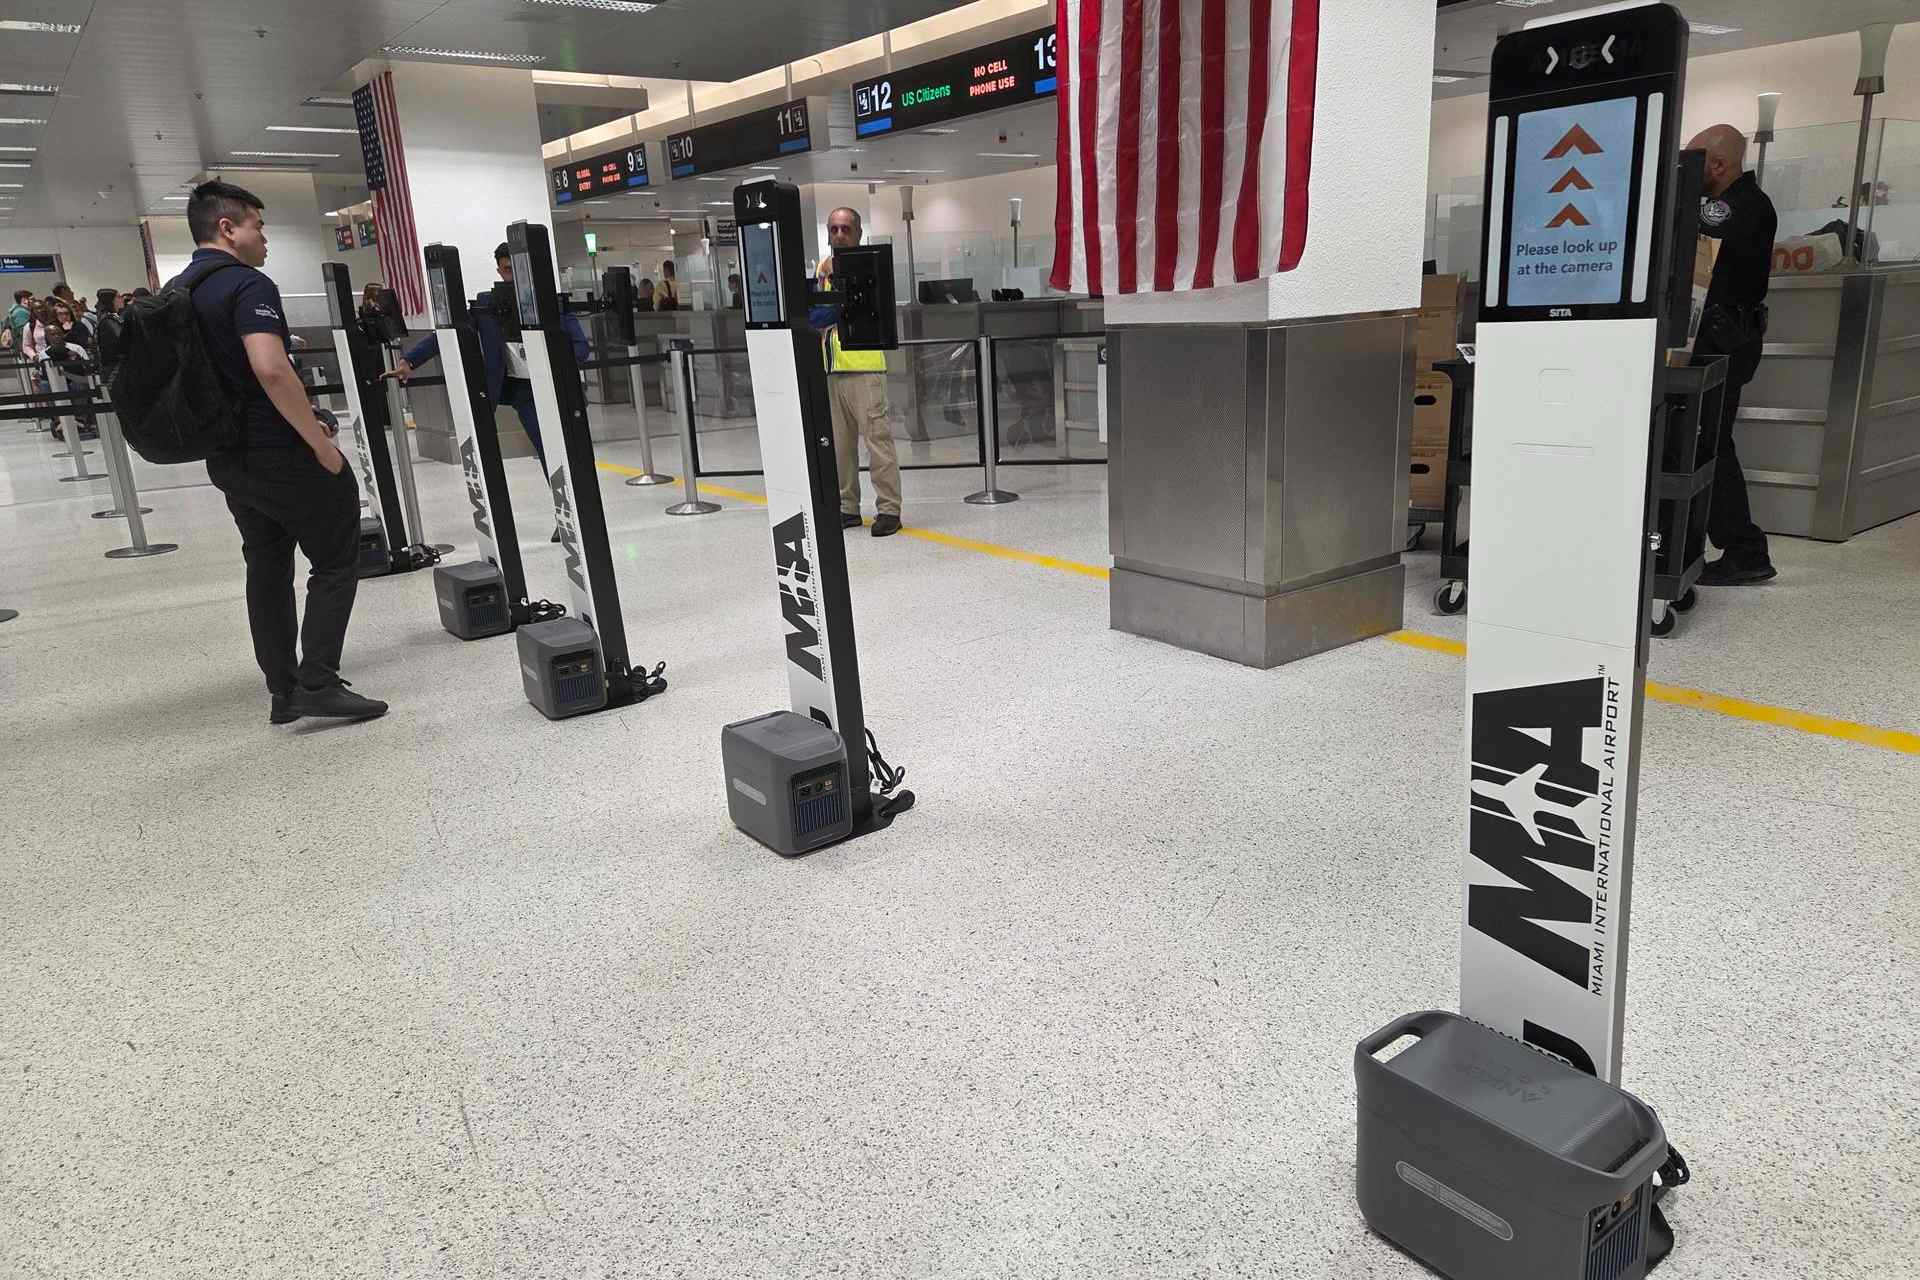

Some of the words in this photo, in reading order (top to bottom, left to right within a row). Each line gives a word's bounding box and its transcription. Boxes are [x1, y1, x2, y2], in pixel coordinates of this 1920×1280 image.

[973, 64, 986, 78] NO
[987, 59, 1008, 74] CELL
[870, 81, 893, 112] 12
[901, 91, 915, 107] US
[916, 84, 951, 104] Citizens
[969, 81, 997, 97] PHONE
[997, 76, 1015, 90] USE
[777, 108, 793, 136] 11
[679, 135, 694, 160] 10
[627, 151, 635, 172] 9
[562, 169, 569, 188] 8
[1516, 243, 1559, 256] Please
[1563, 239, 1594, 254] look
[1598, 241, 1618, 255] up
[1517, 263, 1530, 276] at
[1535, 261, 1557, 275] the
[1560, 261, 1613, 274] camera
[1549, 308, 1572, 318] SITA
[772, 511, 824, 682] MIA
[1603, 676, 1621, 770] AIRPORT
[1469, 677, 1604, 991] MIA
[1594, 776, 1614, 934] INTERNATIONAL
[1591, 941, 1606, 997] MIAMI
